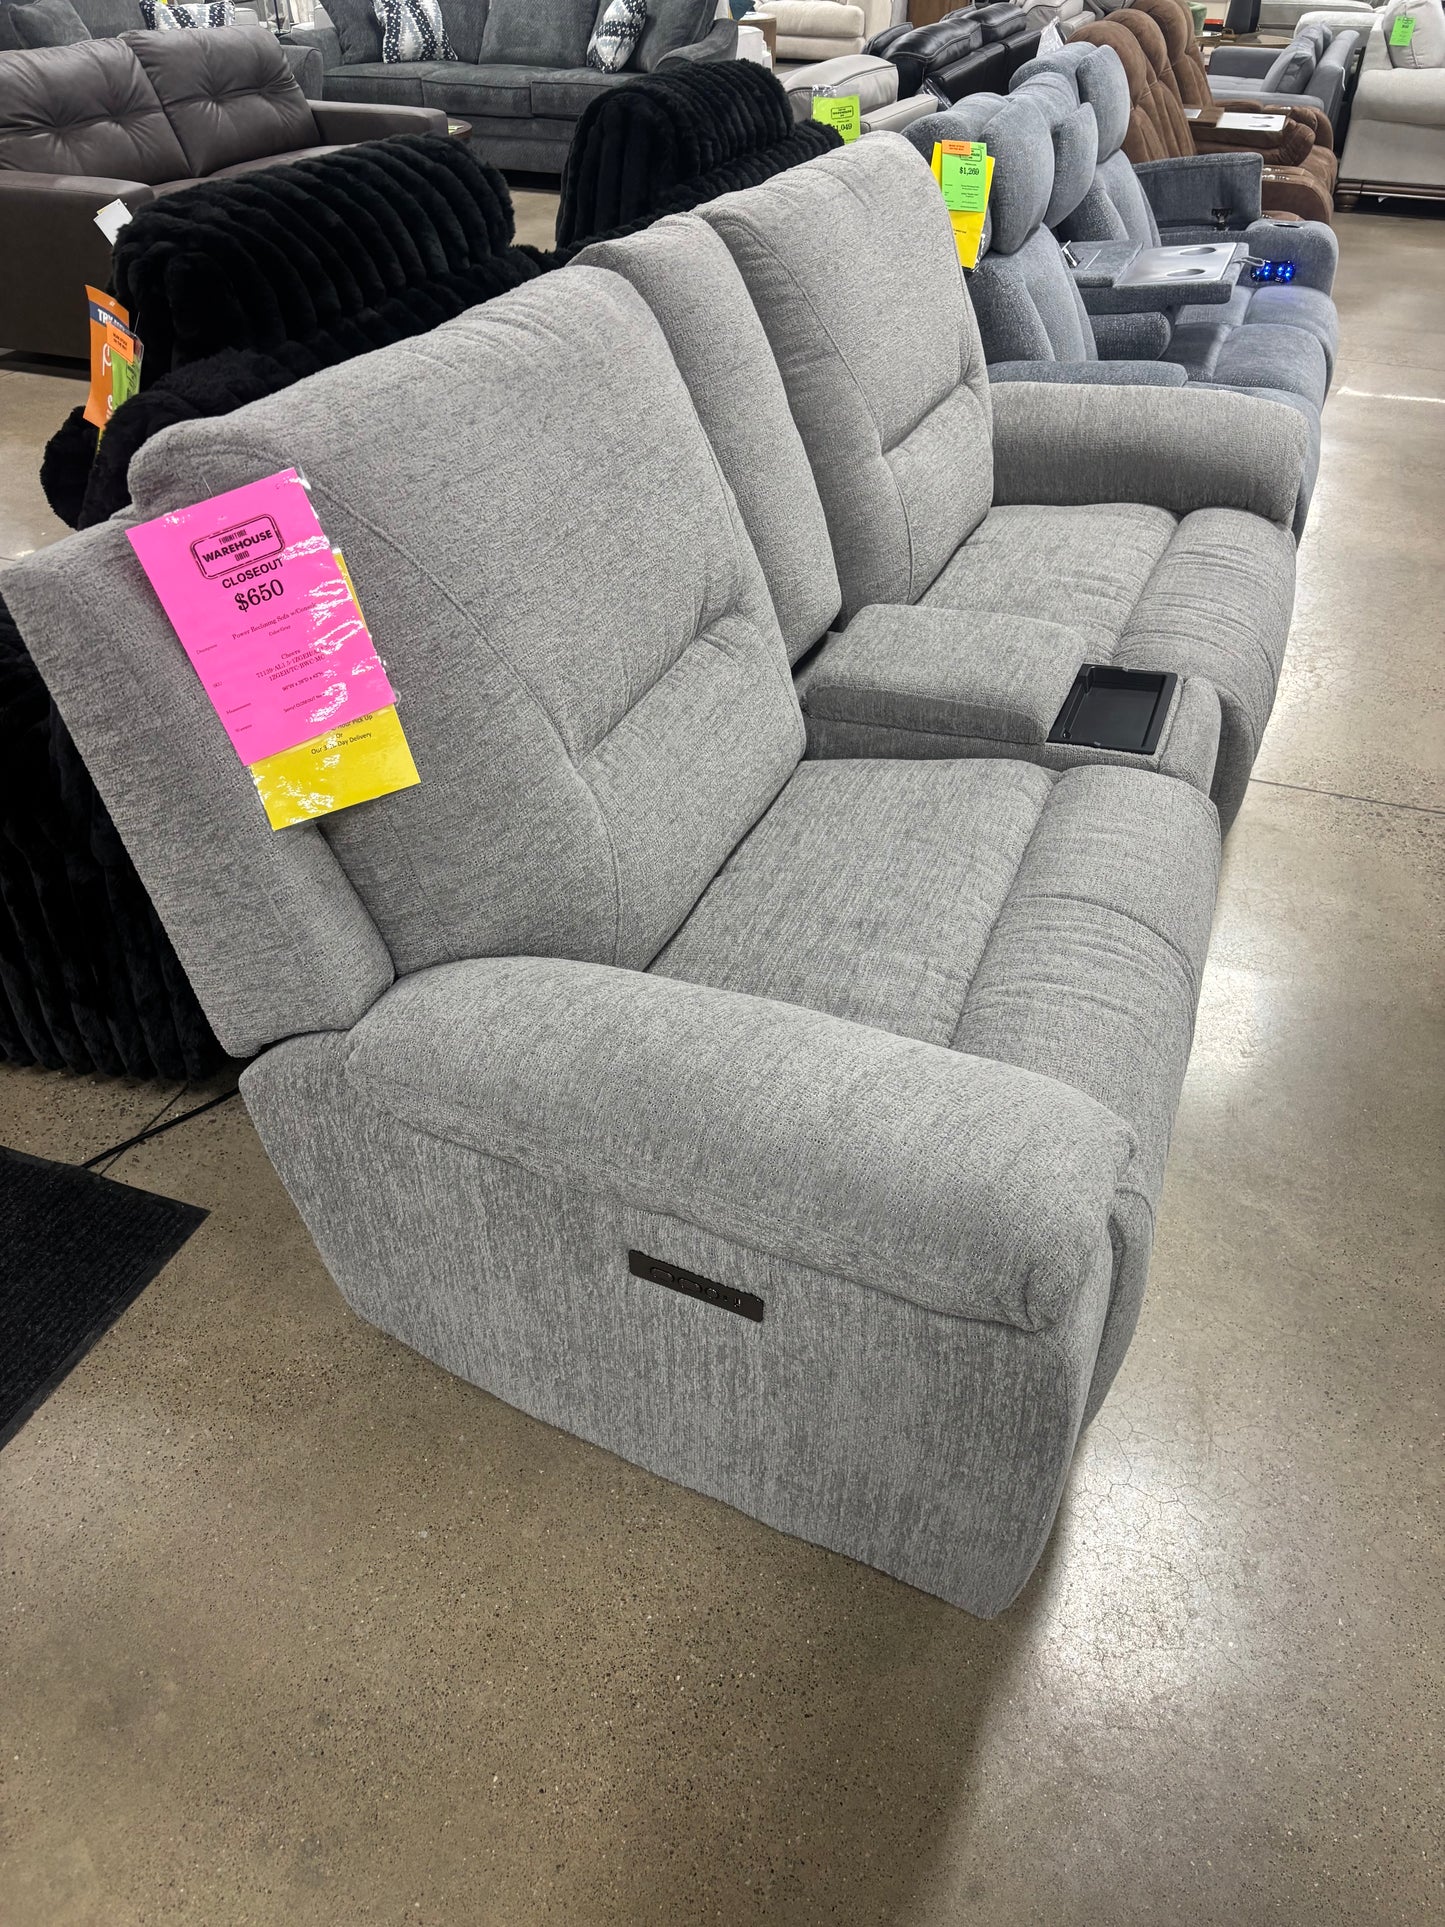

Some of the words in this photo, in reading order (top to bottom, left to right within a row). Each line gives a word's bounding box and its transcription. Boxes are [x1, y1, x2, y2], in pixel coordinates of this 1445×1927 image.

[202, 529, 273, 563] WAREHOUSE
[234, 550, 250, 562] OHIO
[222, 557, 283, 589] CLOSEOUT
[234, 579, 284, 613] $650
[231, 629, 250, 640] Power
[250, 619, 278, 633] Reclining
[276, 613, 290, 623] Sofa
[280, 649, 301, 660] Cheers
[311, 746, 323, 755] Our
[337, 739, 348, 747] Day
[349, 732, 372, 743] Delivery
